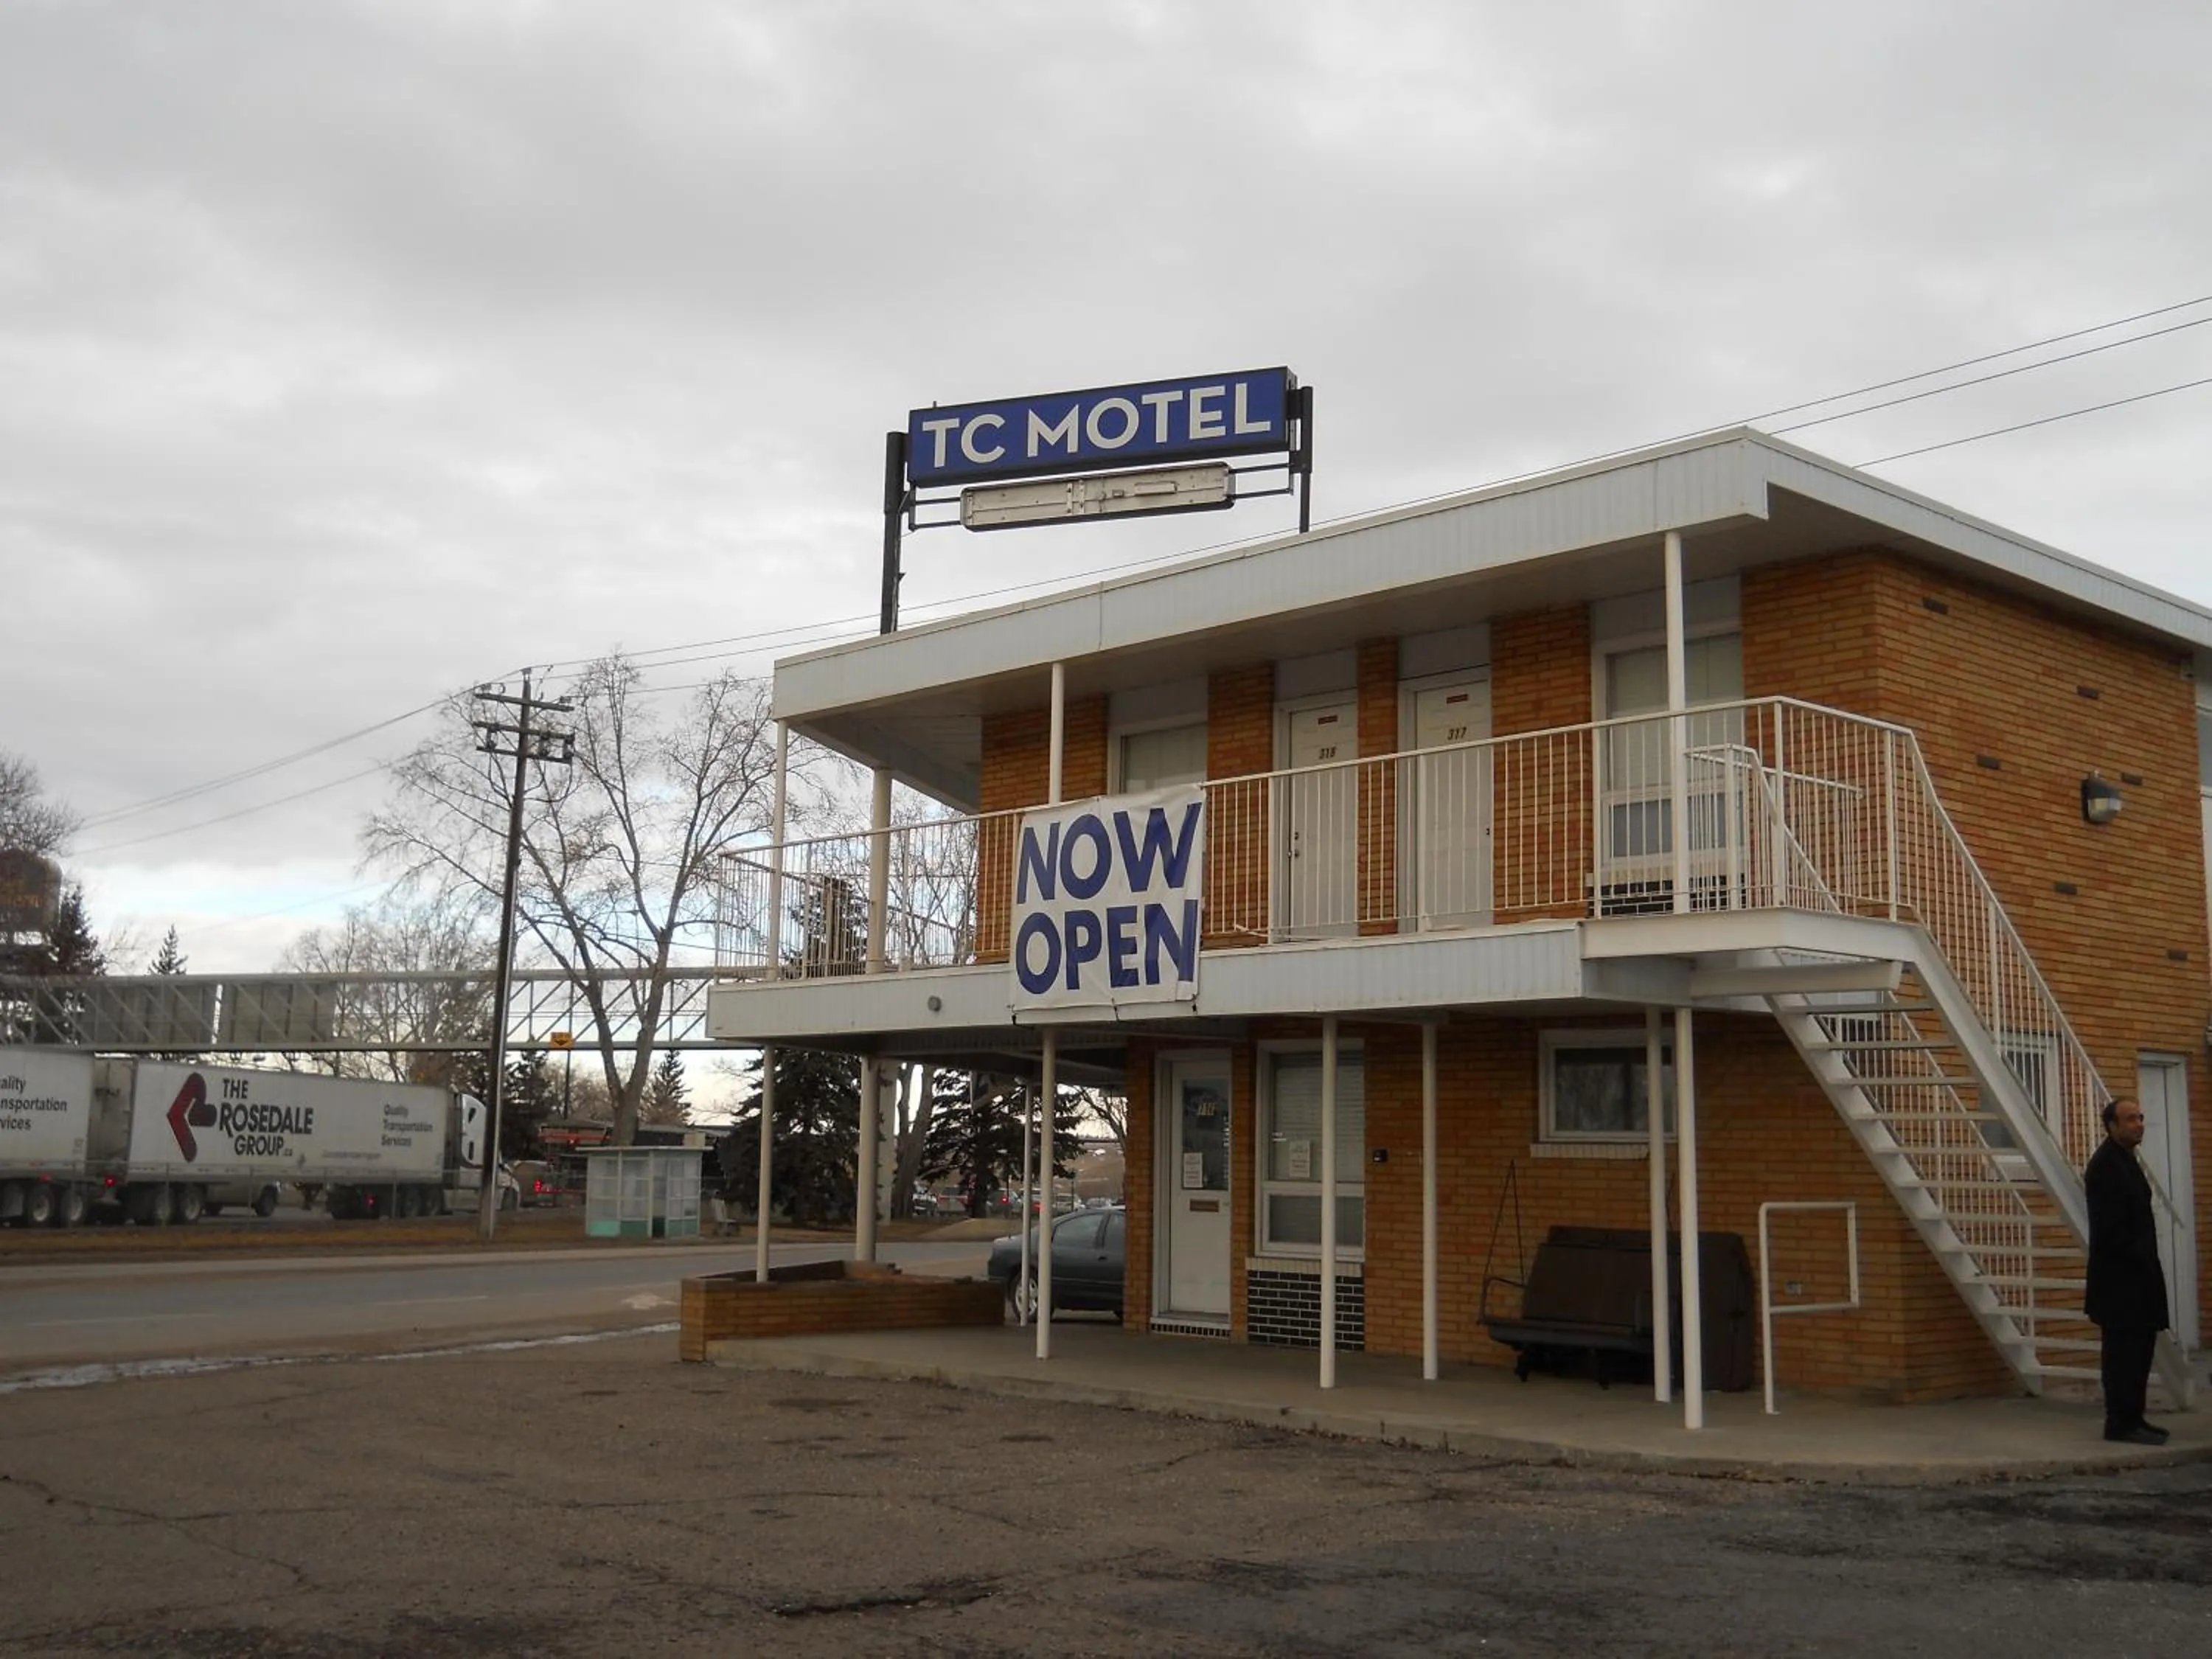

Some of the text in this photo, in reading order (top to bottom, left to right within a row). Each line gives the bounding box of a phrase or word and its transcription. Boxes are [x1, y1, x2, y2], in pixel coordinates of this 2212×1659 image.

[922, 383, 1270, 468] TC MOTEL
[1447, 726, 1467, 740] 317
[1017, 802, 1202, 904] NOW
[1016, 900, 1198, 995] OPEN
[223, 1078, 249, 1099] THE
[220, 1102, 314, 1138] ROSEDALE
[234, 1135, 284, 1155] GROUP
